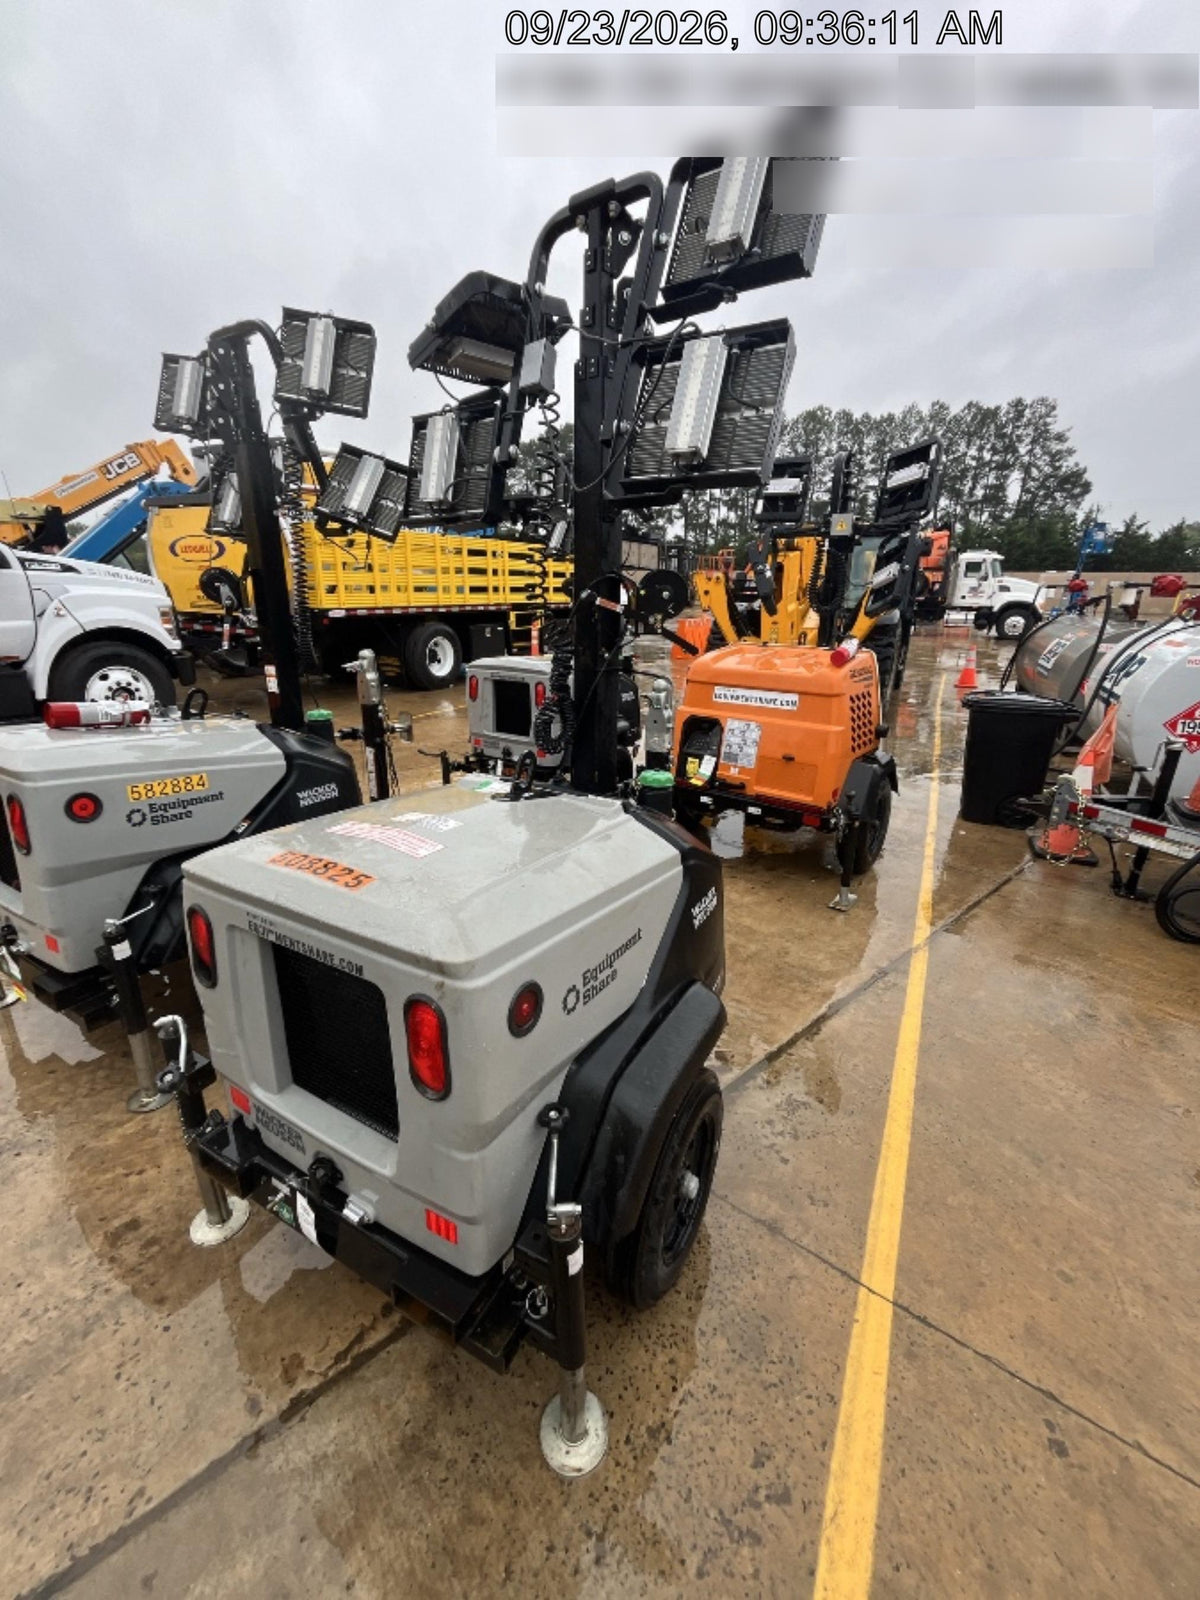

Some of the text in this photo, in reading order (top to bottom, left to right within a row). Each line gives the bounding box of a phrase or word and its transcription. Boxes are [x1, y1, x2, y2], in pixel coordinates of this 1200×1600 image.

[105, 452, 141, 479] JCB
[130, 774, 206, 801] 582884
[148, 791, 224, 814] Equipment
[150, 810, 193, 826] Share
[582, 927, 642, 988] Equipment
[583, 969, 618, 1006] Share
